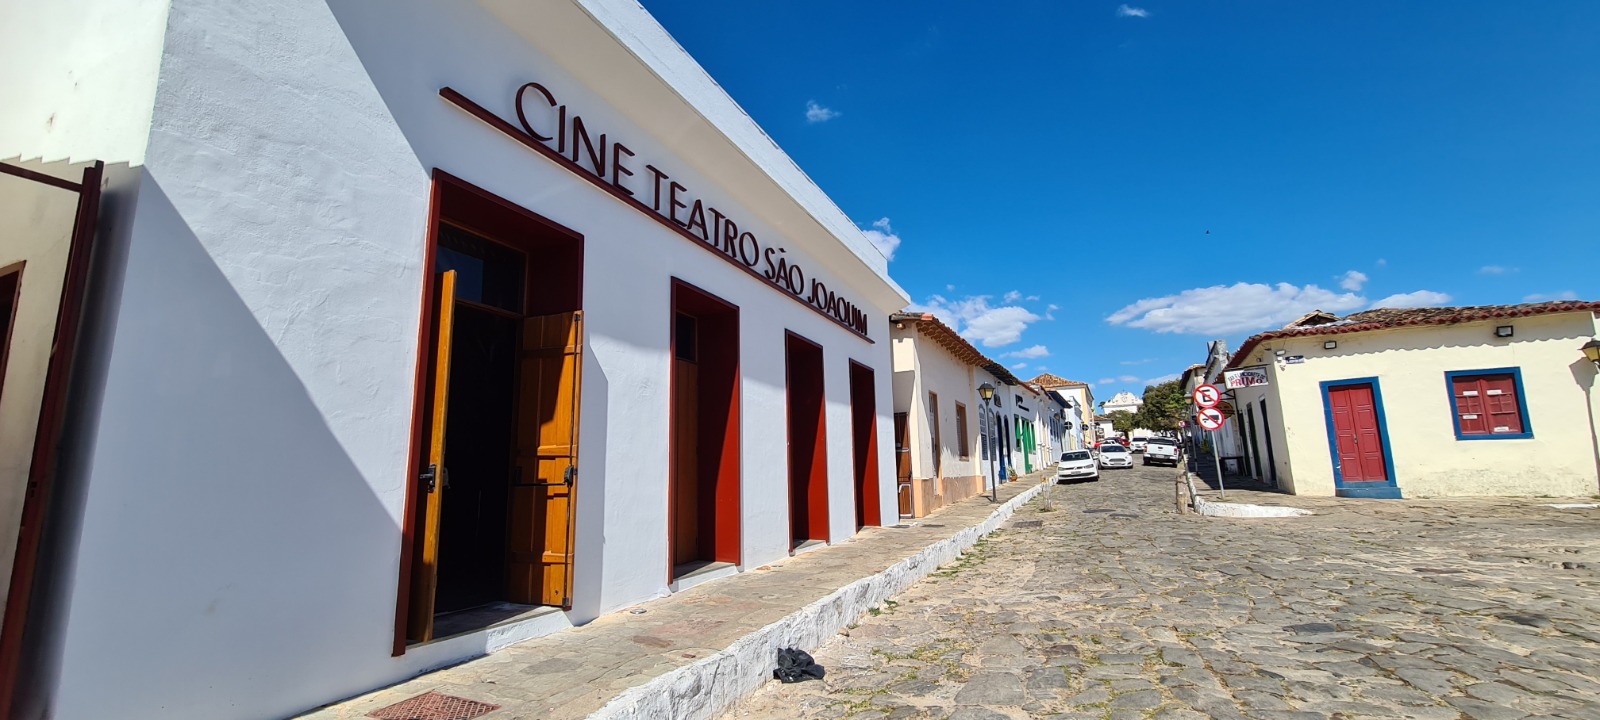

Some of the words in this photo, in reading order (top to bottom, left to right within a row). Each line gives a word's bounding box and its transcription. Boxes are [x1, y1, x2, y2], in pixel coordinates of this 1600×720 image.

[515, 82, 635, 195] CINE
[645, 164, 759, 266] TEATRO
[764, 247, 804, 295] SÃO
[807, 278, 867, 336] JOAQUIM
